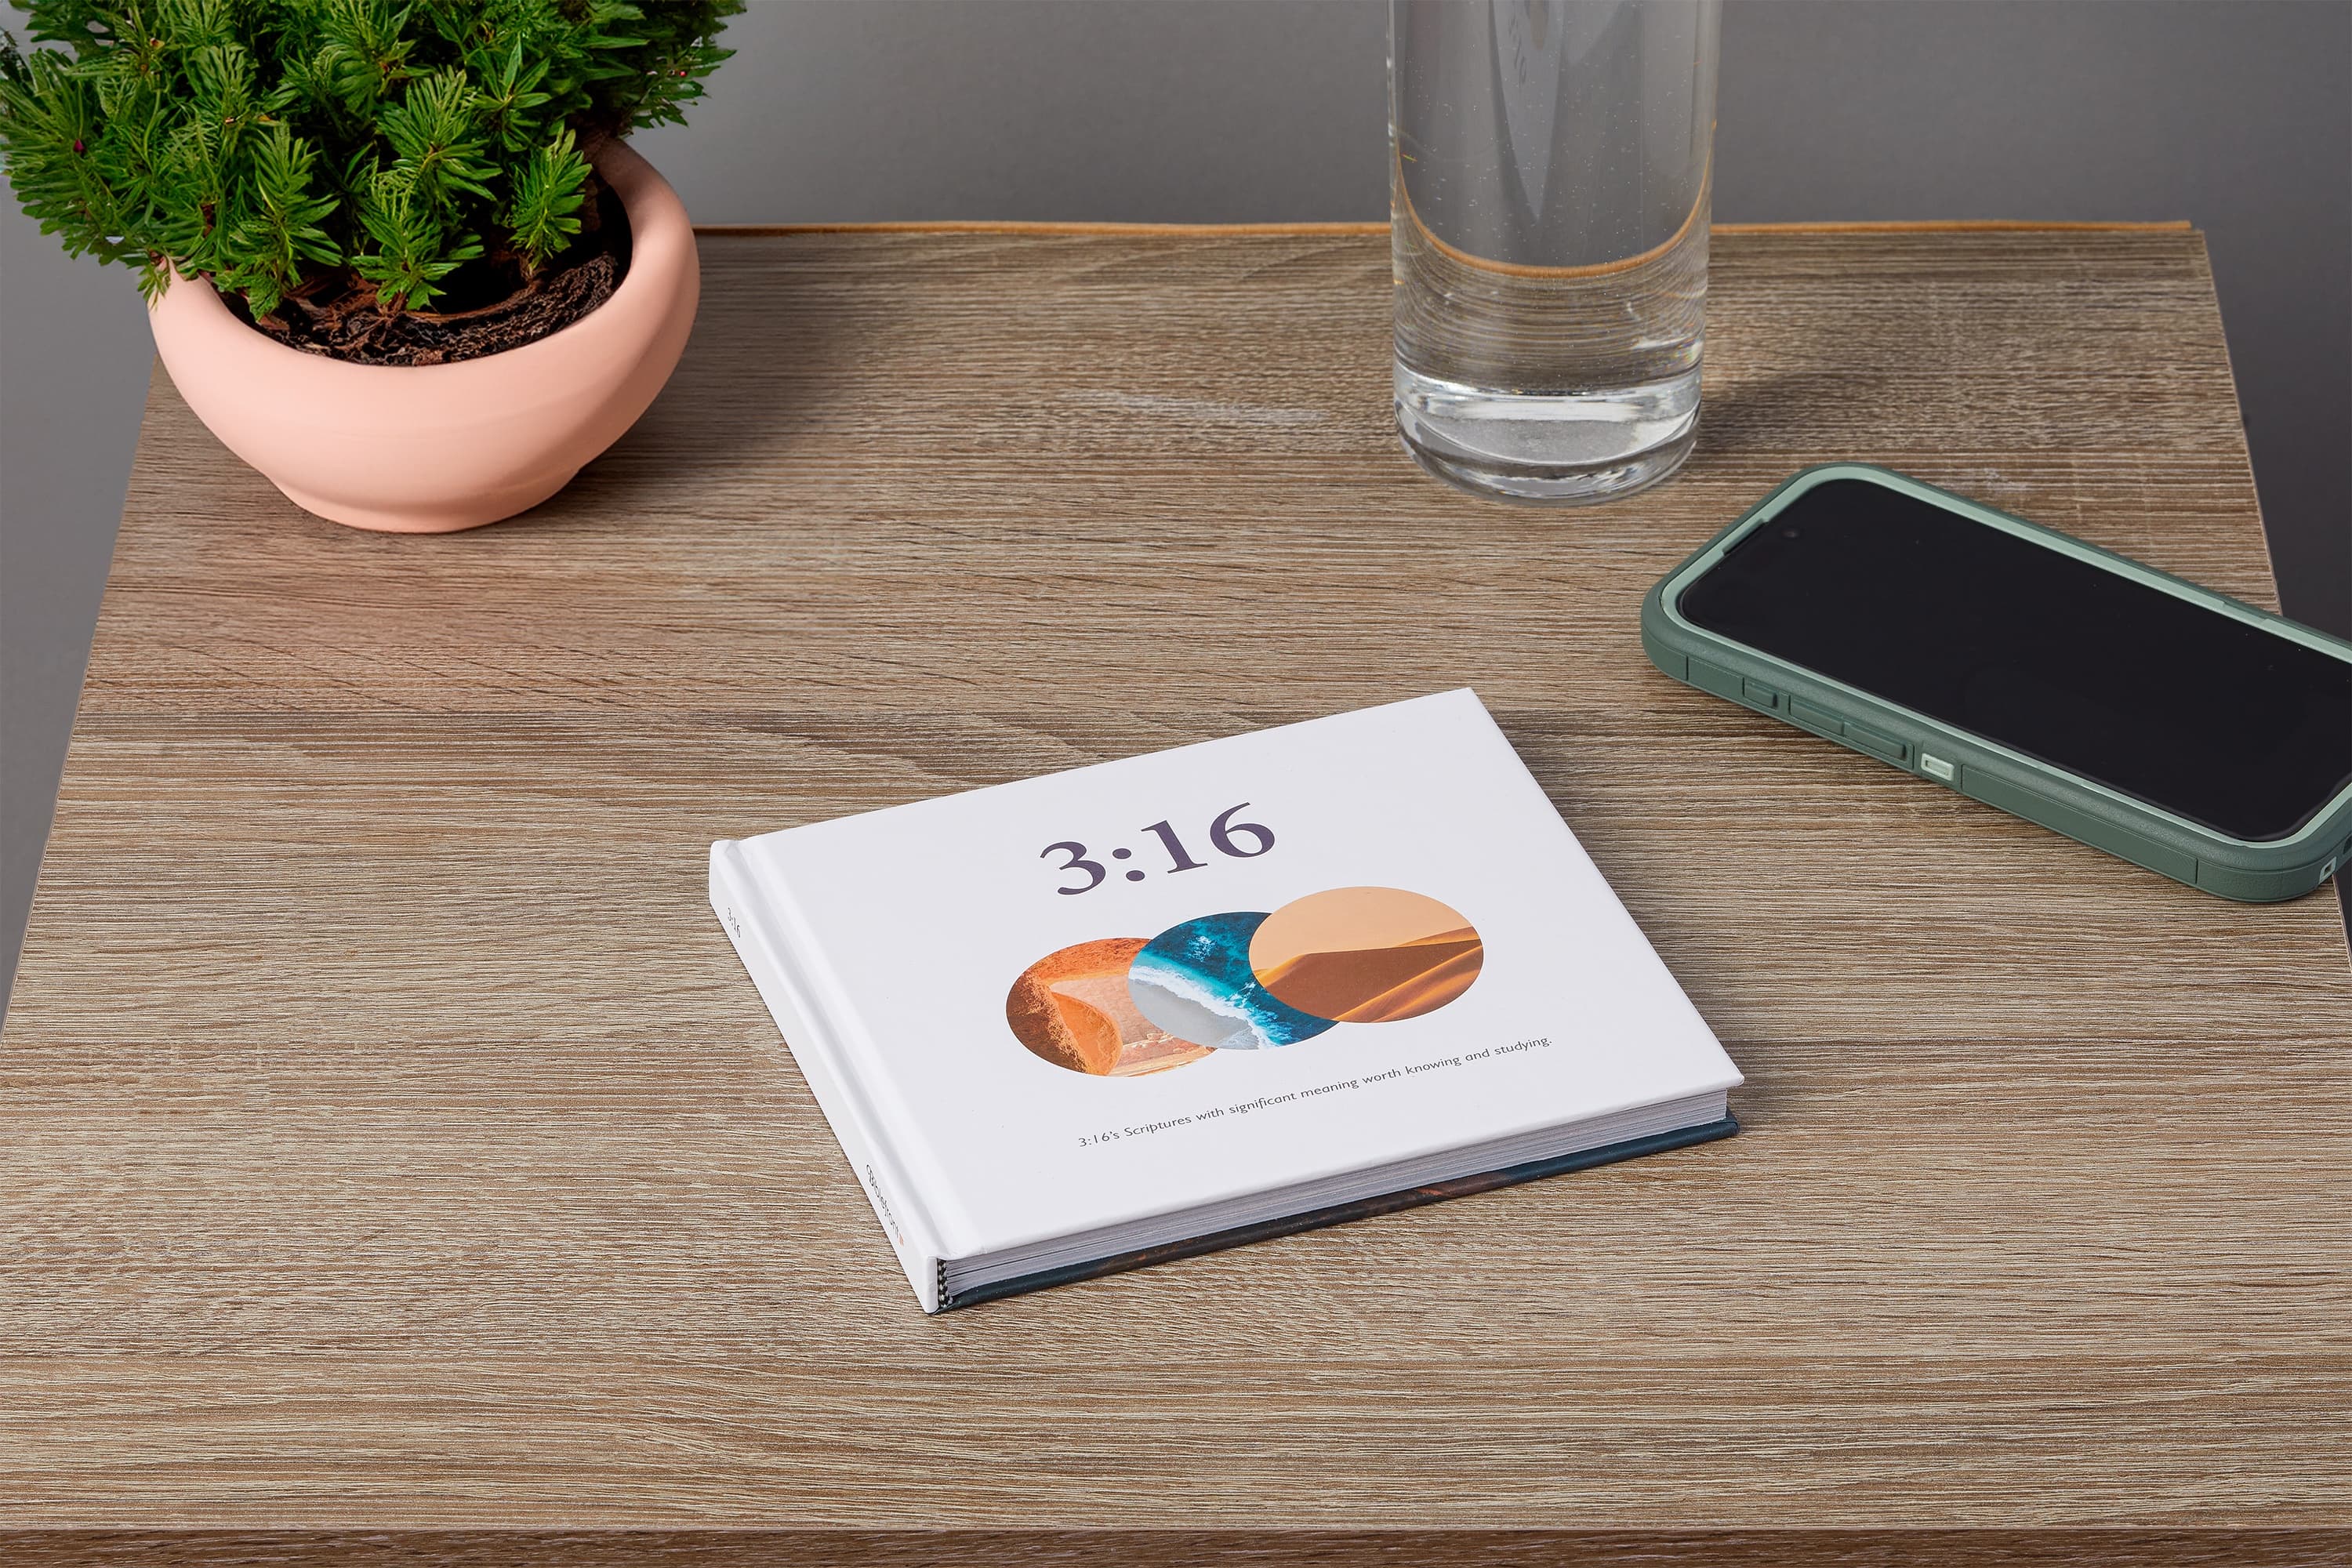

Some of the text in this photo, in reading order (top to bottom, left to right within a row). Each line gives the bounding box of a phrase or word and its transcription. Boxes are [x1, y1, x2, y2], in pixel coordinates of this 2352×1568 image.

[1040, 801, 1276, 895] 3:16
[1078, 1037, 1552, 1147] 3:16's Scriptures with significant meaning worth knowing and studying.
